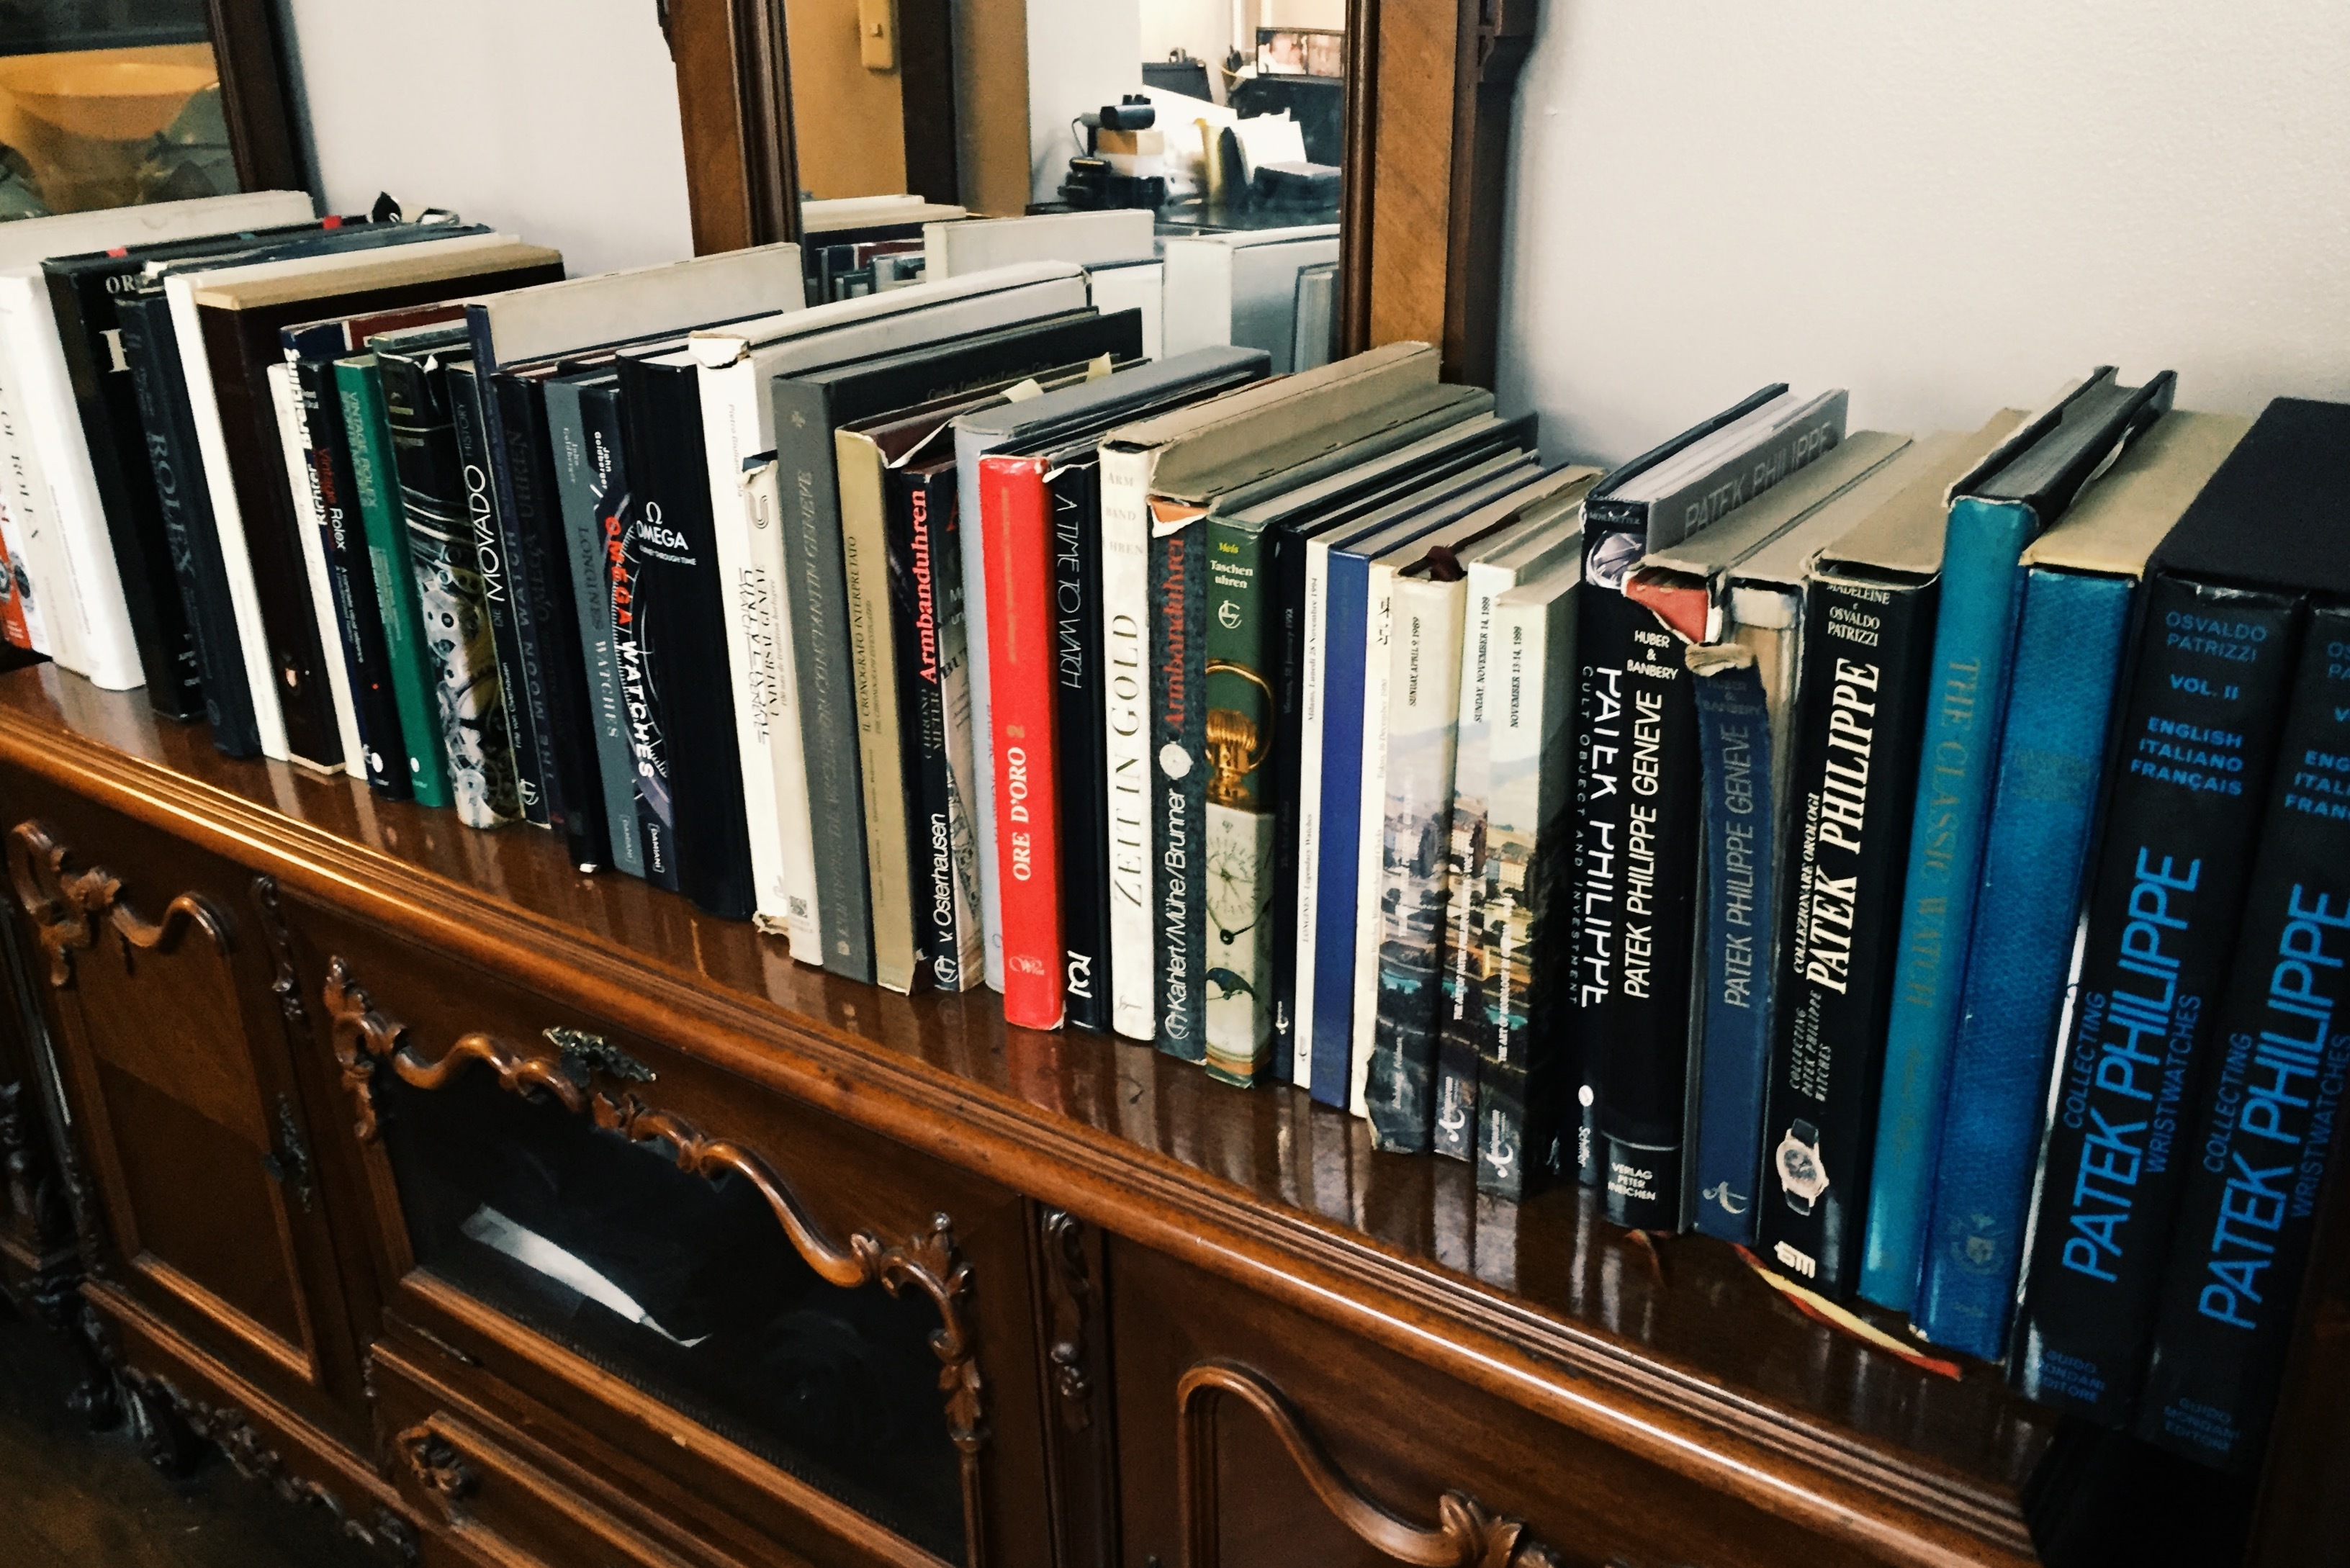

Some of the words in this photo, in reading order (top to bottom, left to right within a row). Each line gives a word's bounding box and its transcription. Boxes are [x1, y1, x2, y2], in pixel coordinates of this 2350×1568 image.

[284, 348, 312, 449] Breitling
[594, 431, 608, 490] Goldberger
[603, 446, 612, 472] John
[1109, 472, 1134, 487] ARM
[328, 508, 347, 553] Rolex
[464, 464, 505, 602] MOVADO
[636, 520, 689, 550] OMEGA
[796, 468, 820, 558] GENEVE
[1055, 494, 1078, 513] A
[500, 528, 533, 627] WATCH
[847, 535, 864, 629] INTERPRETATO
[911, 487, 937, 685] Armbanduhren
[1056, 521, 1079, 572] TIME
[1210, 559, 1253, 577] Taschen
[1215, 575, 1248, 589] uhren
[574, 526, 605, 632] LONGINES
[590, 639, 622, 739] WATCHES
[1058, 577, 1081, 614] TO
[1827, 621, 1879, 647] PATRIZZI
[1829, 605, 1881, 630] OSVALDO
[2166, 610, 2267, 642] OSVALDO
[603, 515, 634, 626] OMEGA
[621, 639, 655, 780] WATCHES
[737, 582, 752, 636] WATCH
[747, 670, 763, 729] GENEVE
[773, 621, 784, 661] tradition
[854, 631, 870, 717] CRONOGRAFO
[1059, 618, 1082, 689] WATCH
[1111, 614, 1141, 736] GOLD
[1476, 631, 1488, 683] NOVEMBER
[1626, 659, 1679, 680] BANBERY
[1634, 630, 1670, 648] HUBER
[1647, 649, 1656, 661] &
[2166, 631, 2257, 662] PATRIZZI
[520, 639, 548, 721] MOON
[1508, 675, 1521, 728] NOVEMBER
[1579, 664, 1593, 718] CULT
[1942, 657, 1981, 730] THE
[536, 733, 557, 780] THE
[1590, 667, 1622, 801] PATEK
[1631, 689, 1663, 797] GENEVE
[1721, 723, 1753, 816] GENEVE
[1819, 657, 1881, 855] PHILIPPE
[2139, 738, 2243, 772] ITALIANO
[2148, 716, 2243, 748] ENGLISH
[1005, 746, 1031, 824] D'ORO
[1115, 756, 1141, 793] IN
[1575, 731, 1590, 816] OBJECT
[1925, 739, 1970, 886] CLASSIC
[2130, 758, 2243, 796] FRANÇAIS
[1010, 829, 1033, 882] ORE
[1114, 808, 1142, 909] ZEIT
[1573, 829, 1584, 868] AND
[1626, 803, 1656, 916] PHILIPPE
[1801, 791, 1821, 863] OROLOGI
[927, 811, 953, 927] Osterhausen
[1725, 819, 1754, 927] PHILIPPE
[1568, 880, 1583, 1005] INVESTMENT
[1581, 819, 1616, 1008] PHILIPPE
[1792, 861, 1814, 974] COLLEZIONARE
[1806, 863, 1858, 995] PATEK
[1906, 894, 1946, 1009] WATCH
[1623, 921, 1652, 999] PATEK
[1724, 932, 1752, 1009] PATEK
[2096, 845, 2202, 1101] PHILIPPE
[1786, 1005, 1809, 1089] COLLECTING
[1802, 988, 1824, 1055] PHILIPPE
[2239, 883, 2350, 1144] PHILIPPE
[2063, 991, 2107, 1129] COLLECTING
[2146, 994, 2202, 1173] WRISTWATCHES
[2203, 1032, 2252, 1173] COLLECTING
[2290, 1033, 2350, 1217] WRISTWATCHES
[1611, 1161, 1653, 1180] VERLAG
[2063, 1107, 2148, 1284] PATEK
[2198, 1151, 2295, 1330] PATEK
